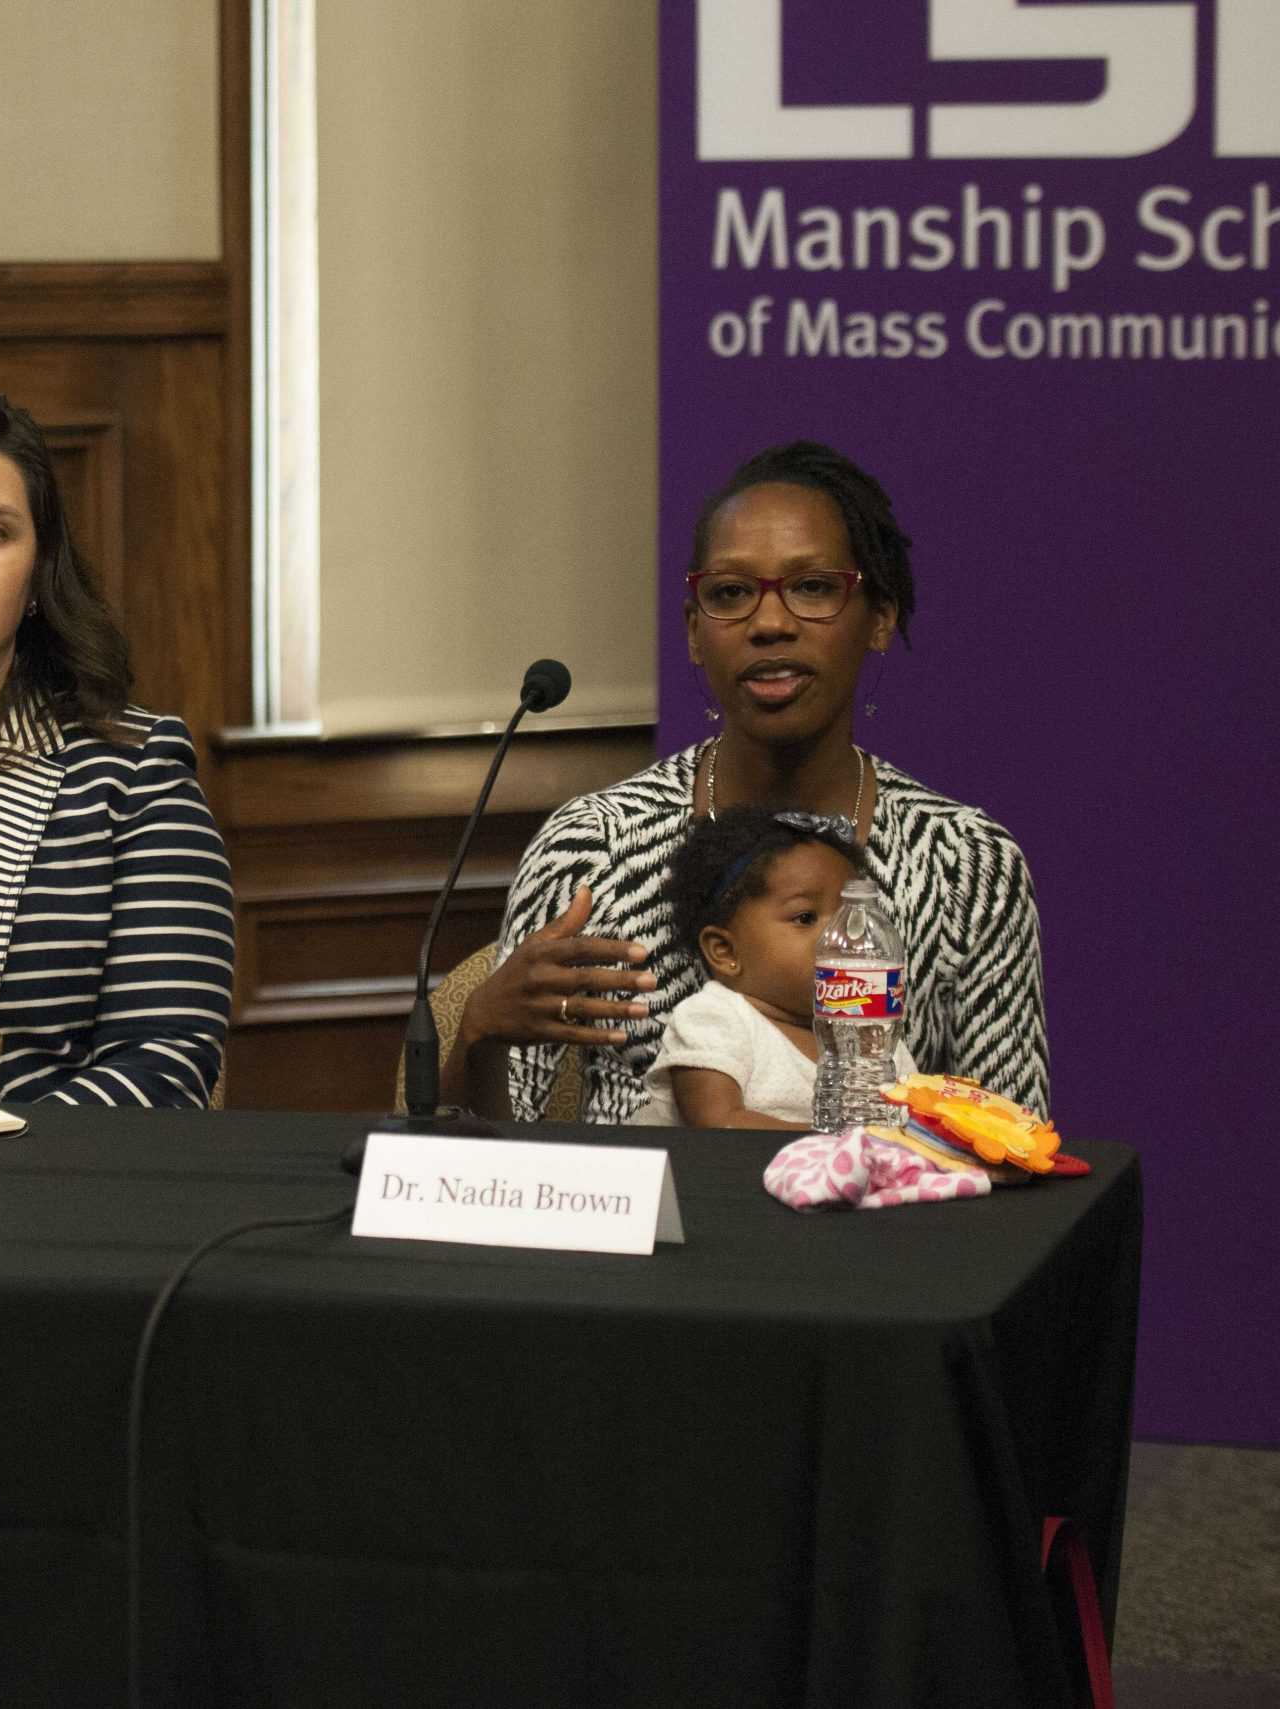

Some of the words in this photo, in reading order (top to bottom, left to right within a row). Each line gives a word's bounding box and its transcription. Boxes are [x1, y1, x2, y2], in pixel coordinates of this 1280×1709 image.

[697, 0, 1280, 161] LS
[712, 185, 1106, 292] Manship
[709, 297, 773, 358] of
[785, 300, 949, 359] Mass
[965, 300, 1280, 360] Communi
[816, 979, 873, 1001] Ozarka
[381, 1173, 425, 1202] Dr.
[436, 1176, 523, 1209] Nadia
[534, 1183, 631, 1215] Brown
